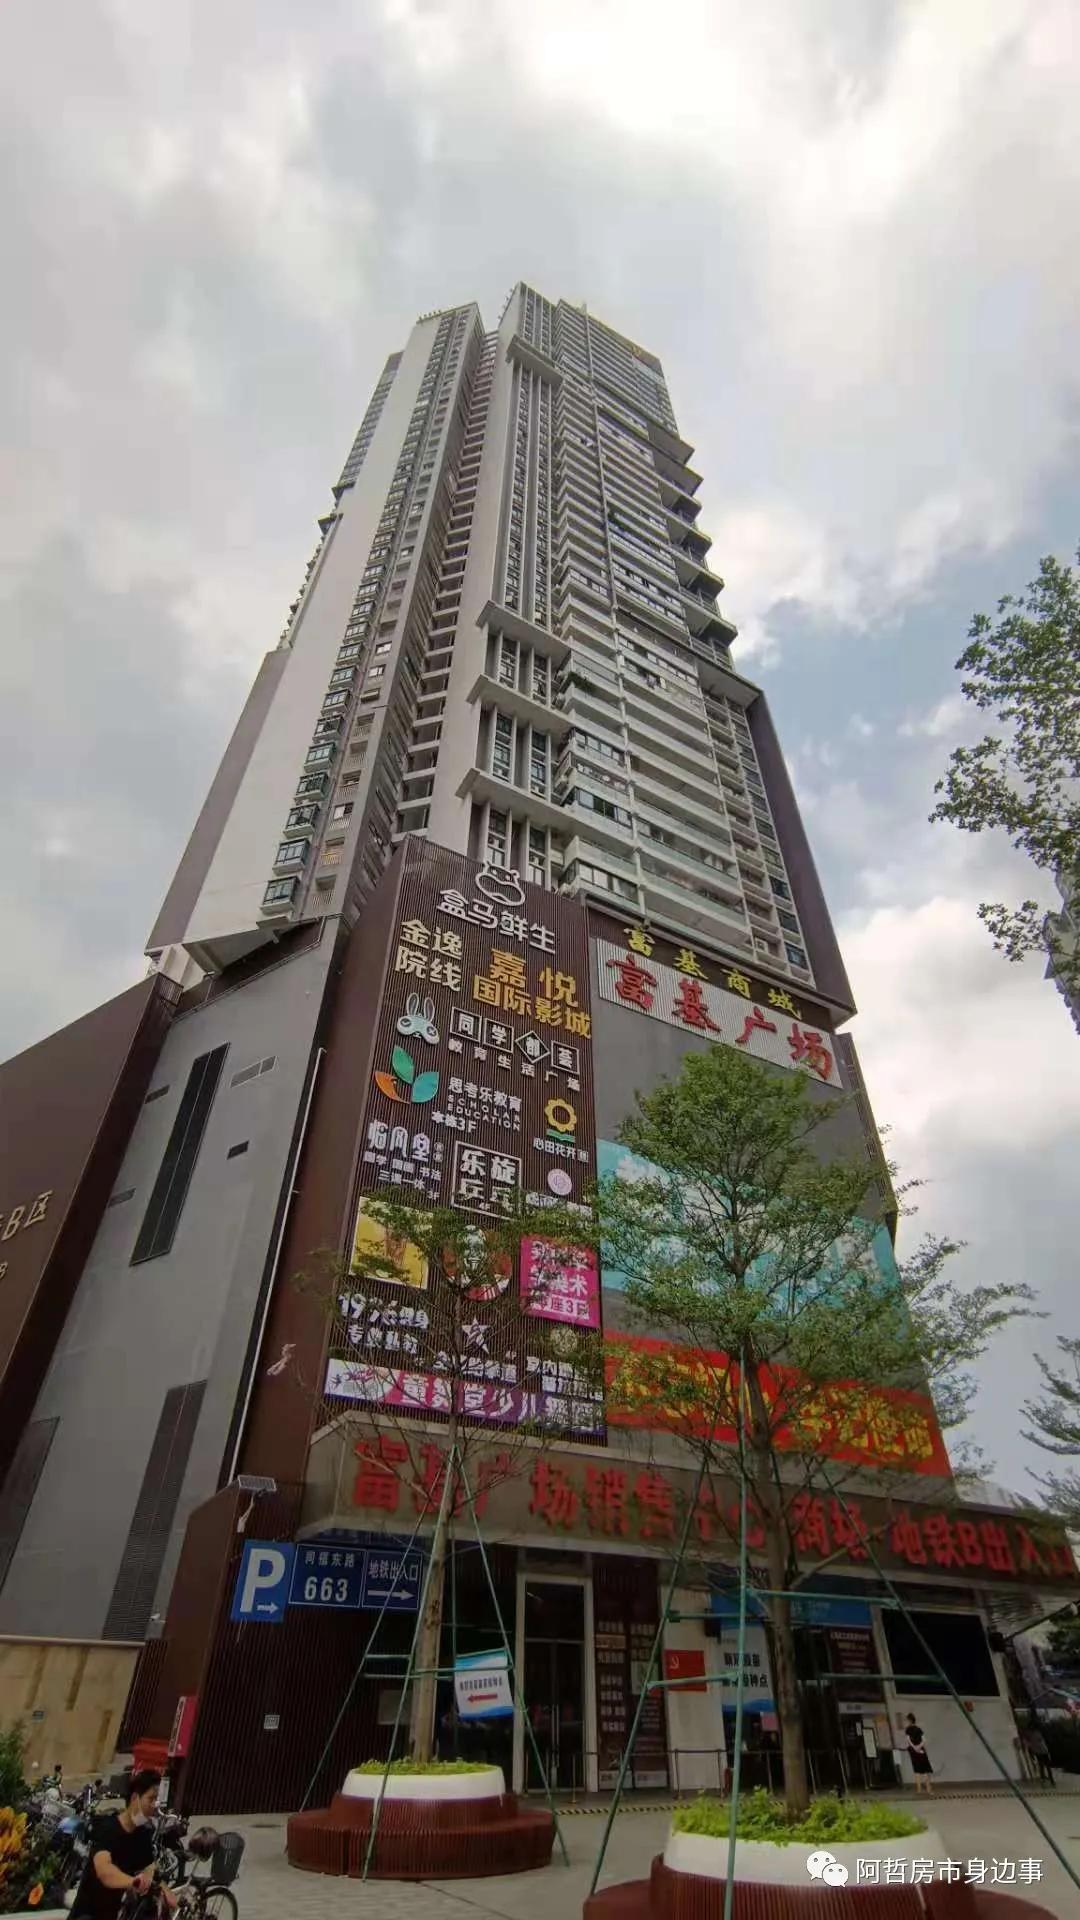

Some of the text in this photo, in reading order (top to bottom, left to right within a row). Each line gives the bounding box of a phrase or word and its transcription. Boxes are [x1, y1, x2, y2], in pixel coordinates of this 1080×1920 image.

[400, 919, 463, 960] 金逸
[437, 888, 556, 955] 盒马鲜生
[395, 946, 463, 992] 院线
[490, 948, 579, 1008] 嘉悦
[624, 927, 802, 1020] 富基商城
[473, 975, 592, 1040] 国际影城
[606, 953, 834, 1080] 富基广场
[448, 1038, 581, 1092] 教育生活广场
[448, 1103, 521, 1132] EDUCATION
[449, 1076, 522, 1113] 思考乐教育
[460, 1149, 517, 1185] 乐旋
[533, 1137, 577, 1161] 心田花开
[0, 1190, 54, 1241] B区
[240, 1547, 286, 1613] P
[304, 1575, 349, 1602] 663
[368, 1558, 419, 1582] 地铁出入口
